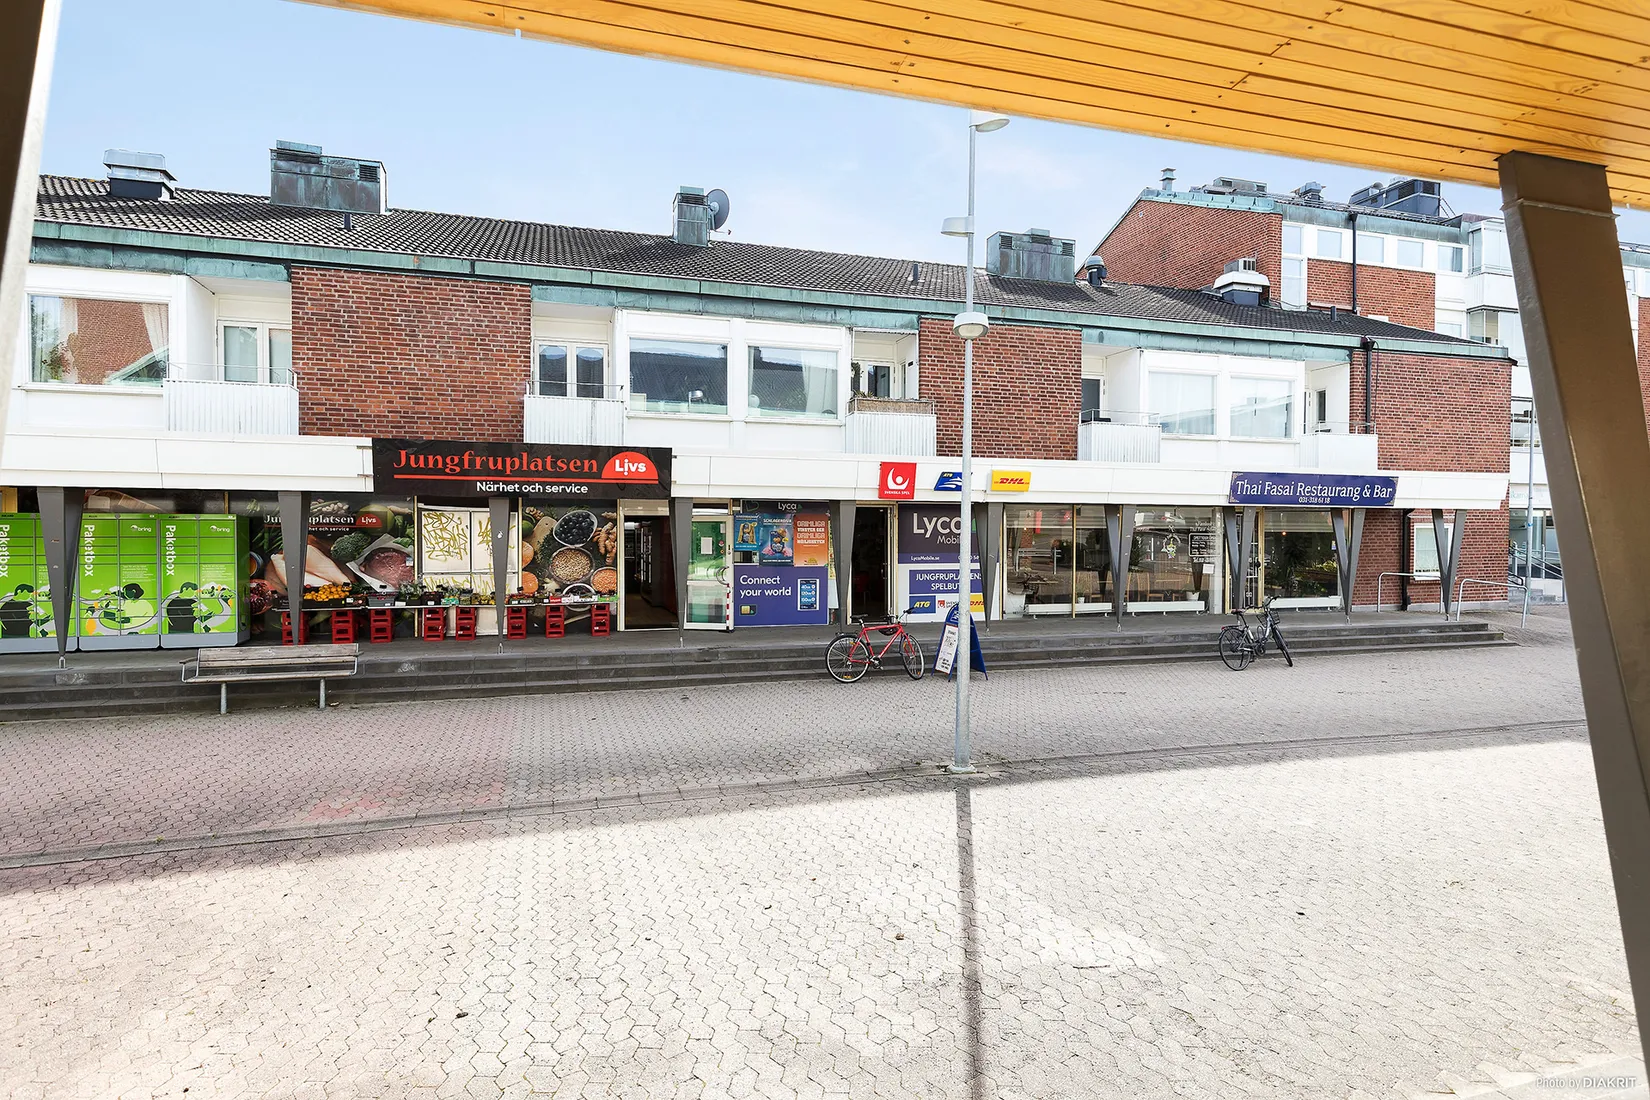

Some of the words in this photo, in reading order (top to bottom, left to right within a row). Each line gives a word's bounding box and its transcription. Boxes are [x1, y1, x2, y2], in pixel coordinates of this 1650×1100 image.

[393, 449, 598, 474] Jungfruplatsen
[614, 458, 647, 476] Livs
[476, 481, 520, 492] Närhet
[522, 482, 543, 493] och
[545, 483, 588, 494] service
[999, 477, 1025, 485] DHL
[1236, 479, 1263, 495] Thai
[1264, 481, 1295, 496] Fasai
[1296, 482, 1360, 501] Restaurang
[1362, 484, 1371, 498] &
[1373, 484, 1393, 498] Bar
[778, 502, 797, 511] Lyca
[361, 516, 377, 524] Livs
[84, 524, 95, 577] Paketbox
[165, 525, 177, 576] Paketbox
[740, 575, 781, 585] Connect
[740, 588, 762, 599] your
[764, 586, 792, 596] world
[914, 600, 931, 608] ATG
